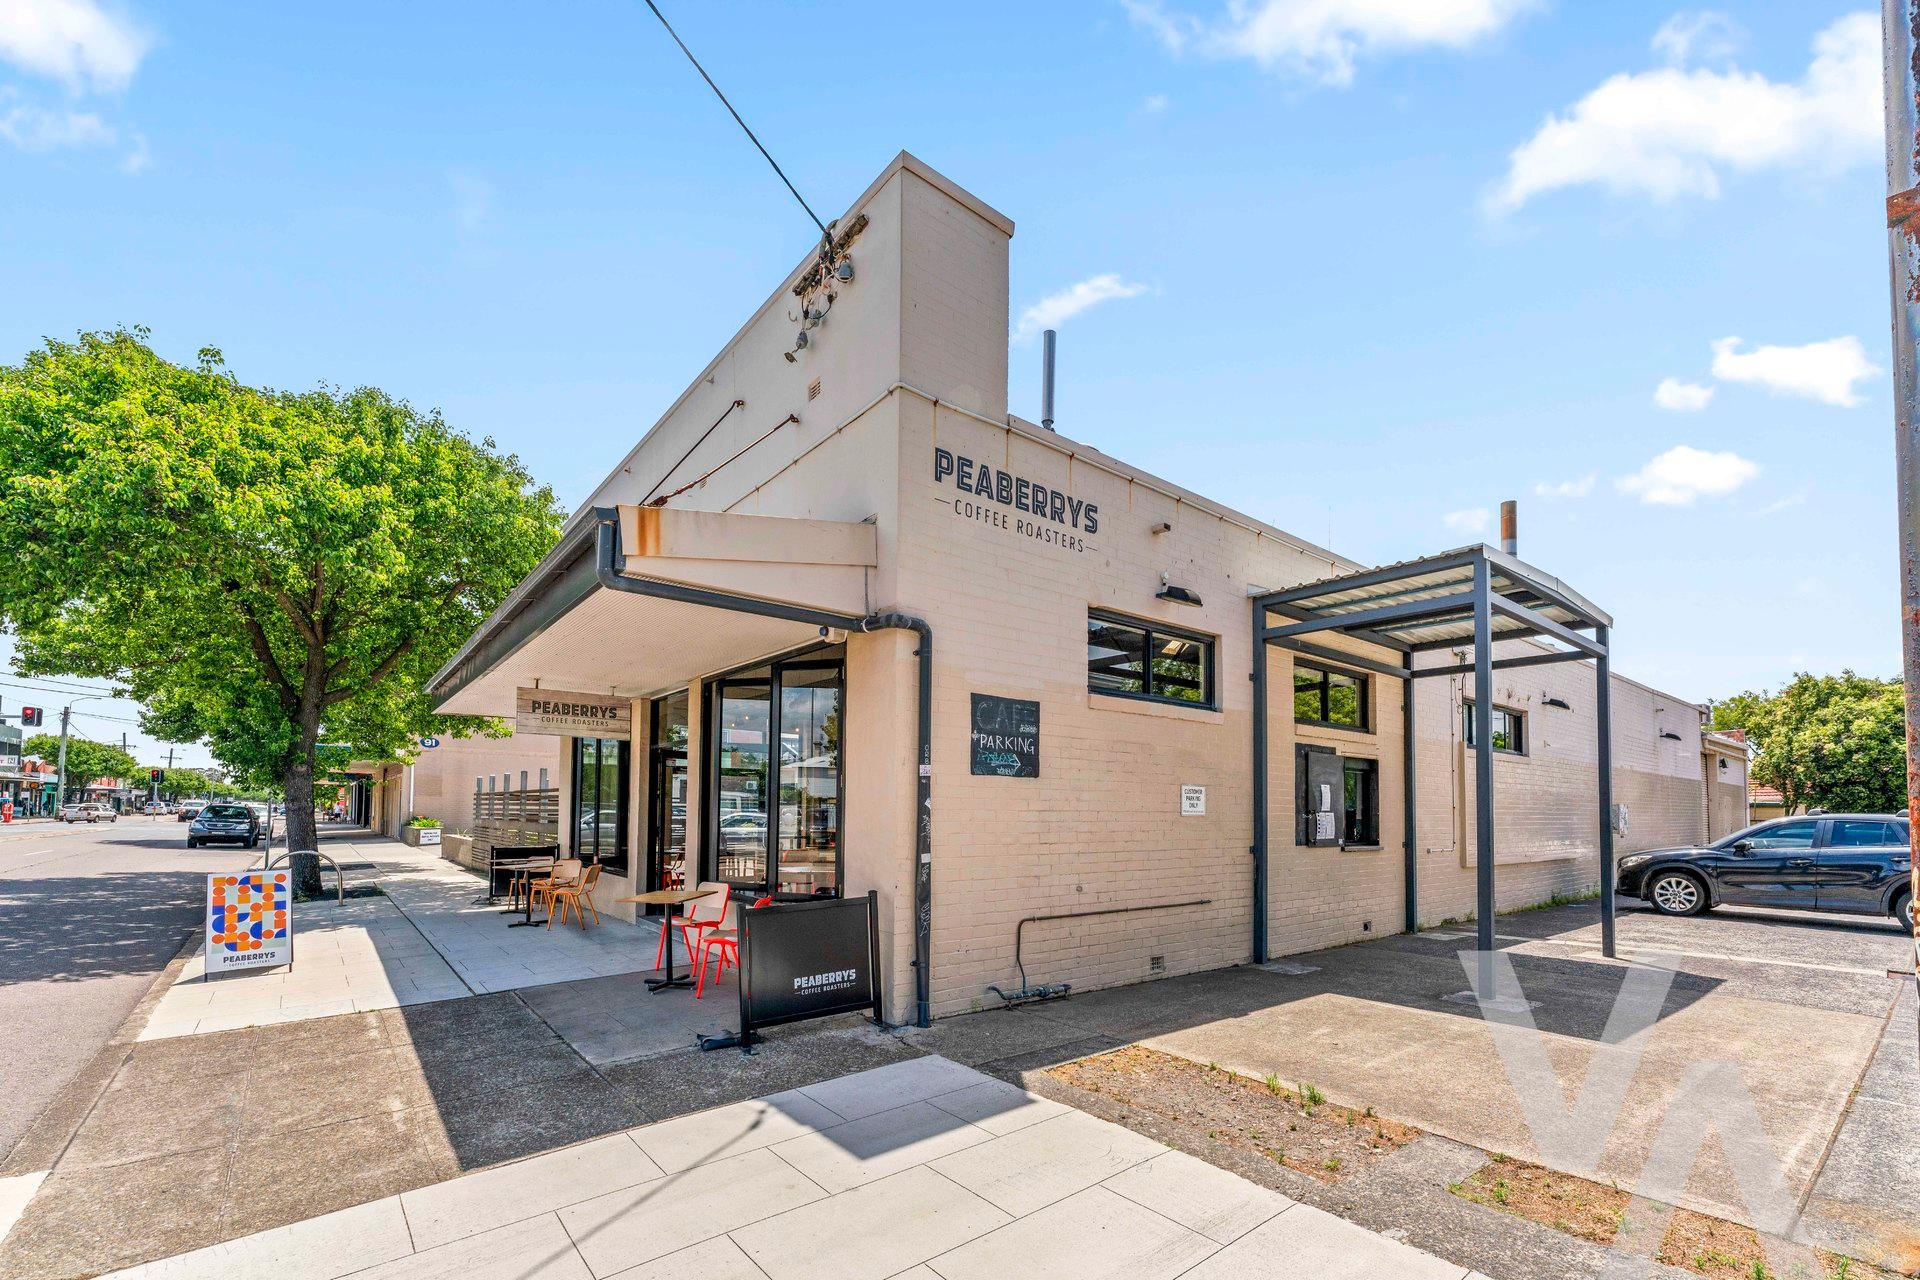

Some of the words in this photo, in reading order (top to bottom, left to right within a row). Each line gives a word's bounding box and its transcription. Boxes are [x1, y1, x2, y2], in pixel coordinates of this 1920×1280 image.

[934, 446, 1098, 534] PEABERRYS
[954, 499, 1008, 530] COFFEE
[1016, 519, 1084, 553] ROASTERS
[531, 700, 618, 719] PEABERRYS
[541, 716, 568, 724] COFFEE
[572, 719, 609, 727] ROASTERS
[980, 733, 1035, 755] PARKING
[223, 951, 276, 964] PEABERRYS
[793, 968, 857, 989] PEABERRYS
[801, 986, 821, 996] COFFEE
[823, 982, 851, 992] ROASTERS
